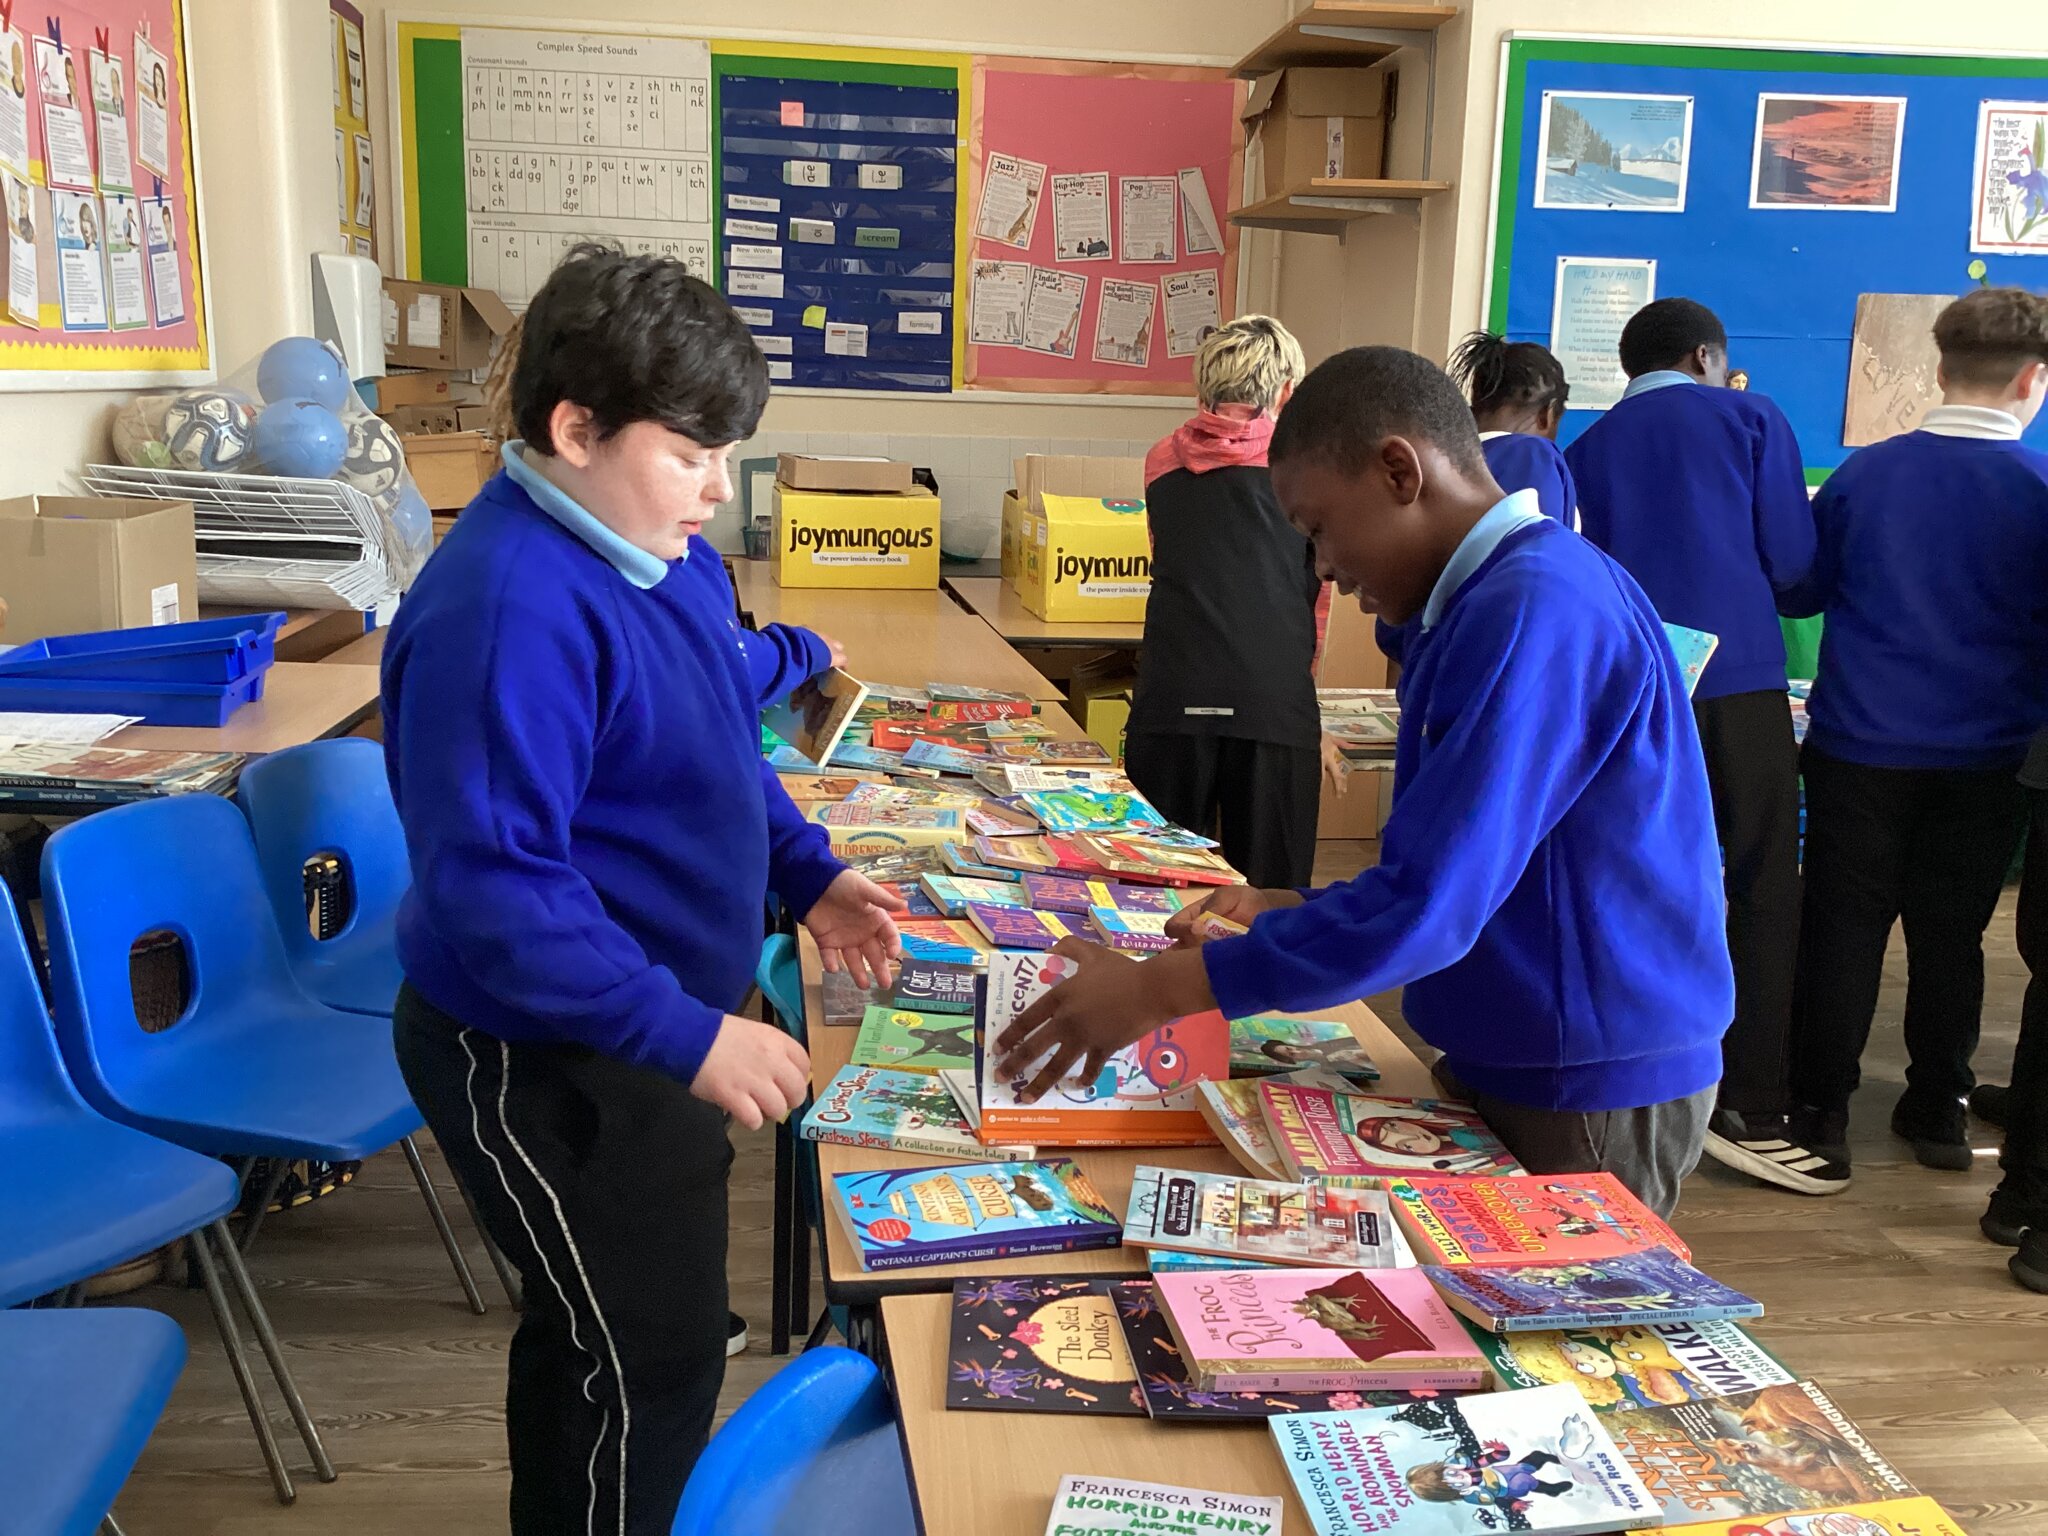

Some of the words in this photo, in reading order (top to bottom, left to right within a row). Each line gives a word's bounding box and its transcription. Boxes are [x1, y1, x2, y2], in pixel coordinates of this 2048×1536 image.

[537, 41, 574, 52] Complex
[577, 44, 603, 54] Speed
[606, 46, 638, 56] Sounds
[467, 56, 503, 65] Consonant
[504, 58, 528, 67] sounds
[518, 75, 528, 84] m
[647, 80, 660, 91] sh
[670, 82, 681, 92] th
[690, 84, 704, 96] ng
[513, 90, 533, 98] mm
[537, 91, 552, 99] nn
[562, 92, 572, 100] rr
[583, 93, 594, 101] ss
[604, 94, 617, 103] ve
[626, 95, 638, 104] zz
[649, 94, 658, 105] ti
[690, 98, 704, 107] nk
[471, 101, 486, 114] ph
[496, 101, 506, 111] le
[514, 102, 532, 112] mb
[537, 102, 552, 113] kn
[559, 106, 574, 114] wr
[583, 107, 594, 115] se
[649, 108, 659, 119] ci
[626, 123, 639, 131] se
[583, 134, 595, 144] ce
[601, 162, 614, 172] qu
[690, 163, 703, 175] ch
[995, 161, 1015, 172] Jazz
[472, 167, 486, 178] bb
[509, 169, 523, 180] dd
[528, 173, 541, 182] gg
[583, 175, 597, 185] pp
[622, 176, 632, 185] tt
[637, 175, 654, 186] wh
[690, 178, 705, 189] tch
[1129, 184, 1143, 192] Pop
[492, 182, 504, 192] ck
[566, 187, 578, 197] ge
[492, 197, 504, 207] ch
[562, 200, 579, 210] dge
[493, 220, 516, 228] sounds
[638, 243, 650, 251] ee
[661, 241, 679, 254] igh
[688, 245, 704, 254] ow
[862, 234, 895, 243] scream
[505, 250, 519, 259] ea
[737, 272, 765, 281] Practice
[1038, 274, 1057, 283] Indie
[1573, 270, 1598, 279] HOLD
[1616, 271, 1642, 280] HAND
[1170, 281, 1189, 291] Soul
[789, 519, 933, 556] joymungous
[1054, 547, 1154, 585] joymun
[1097, 587, 1118, 595] power
[39, 792, 63, 800] Secrets
[72, 792, 82, 800] the
[84, 793, 96, 801] Sea
[1121, 939, 1148, 948] ROALD
[909, 970, 931, 988] GREAT
[931, 971, 954, 991] GHOST
[861, 1045, 877, 1060] Jill
[871, 1010, 888, 1045] Tomlinson
[816, 1078, 854, 1123] Christmas
[850, 1069, 878, 1092] Stories
[1266, 1085, 1302, 1131] McKAY
[1304, 1096, 1330, 1121] Rose
[807, 1126, 855, 1146] Christmas
[858, 1131, 891, 1149] Stories
[894, 1137, 903, 1148] A
[984, 1148, 1006, 1160] tales
[1288, 1132, 1328, 1171] HILARY
[1320, 1121, 1361, 1167] Permanent
[913, 1183, 942, 1222] KINTANA
[935, 1176, 969, 1225] CAPTAIN'S
[971, 1177, 1008, 1218] CURSE
[1177, 1202, 1189, 1211] the
[1176, 1217, 1187, 1231] Stuck
[1408, 1203, 1439, 1232] WORLD
[871, 1256, 913, 1267] KINTANA
[921, 1251, 967, 1262] CAPTAIN'S
[968, 1248, 996, 1258] CURSE
[1200, 1285, 1230, 1325] FROG
[1220, 1273, 1303, 1355] Princess
[1514, 1318, 1531, 1326] More
[1532, 1317, 1548, 1326] Tales
[1556, 1316, 1571, 1325] Give
[1572, 1316, 1584, 1324] You
[1629, 1312, 1656, 1321] SPECIAL
[1658, 1310, 1689, 1320] EDITION
[1085, 1311, 1117, 1361] Donkey
[1208, 1326, 1222, 1340] THE
[1713, 1319, 1749, 1349] MILLIO
[1056, 1336, 1082, 1364] The
[1654, 1322, 1757, 1395] WALKE
[1712, 1333, 1754, 1370] MYSTERY
[1747, 1349, 1785, 1382] MISSING
[1321, 1377, 1346, 1386] FROG
[1347, 1376, 1388, 1388] Princess
[1797, 1380, 1880, 1466] McCAUGHREN
[1287, 1420, 1315, 1461] SIMON
[1309, 1421, 1348, 1472] HENRY
[1362, 1435, 1414, 1508] SNOWMAN
[1587, 1460, 1595, 1474] by
[1598, 1453, 1623, 1480] Ross
[1646, 1428, 1749, 1508] FREE
[1594, 1470, 1622, 1507] Illustrated
[1876, 1464, 1910, 1494] TOM
[1071, 1481, 1191, 1505] FRANCESCA
[1202, 1497, 1272, 1517] SIMON
[1307, 1467, 1351, 1536] FRANCESCA
[1612, 1478, 1643, 1513] Tony
[1176, 1509, 1272, 1535] HENRY
[1377, 1513, 1391, 1529] AND
[1386, 1508, 1400, 1522] THE
[1630, 1519, 1652, 1528] Orion
